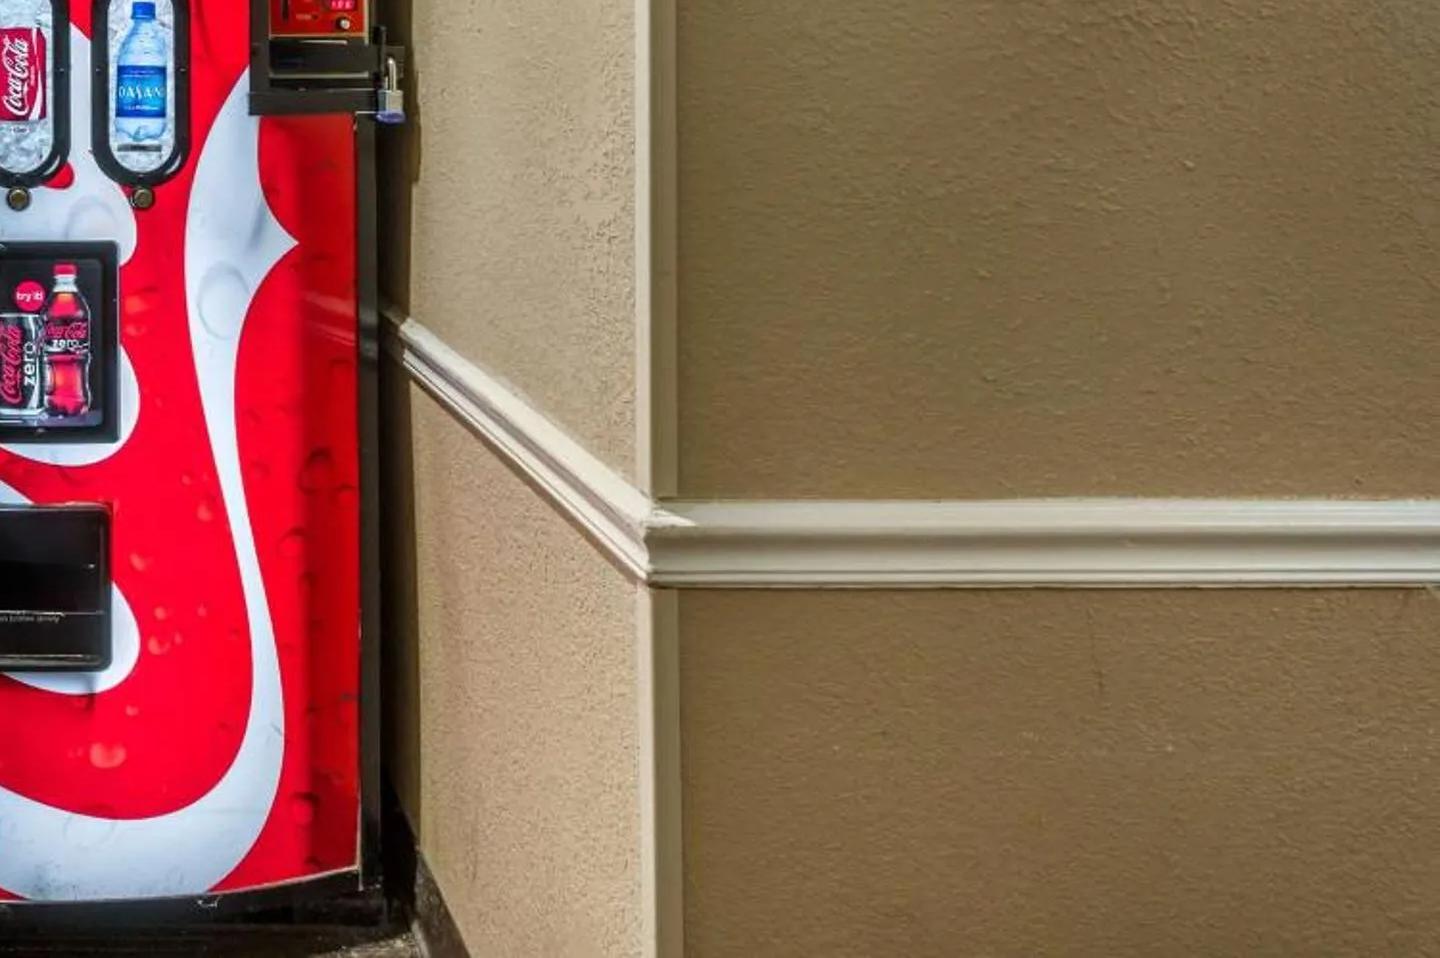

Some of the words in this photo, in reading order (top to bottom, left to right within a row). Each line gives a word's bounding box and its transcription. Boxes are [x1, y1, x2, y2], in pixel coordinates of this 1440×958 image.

[16, 292, 31, 302] try
[52, 339, 79, 349] zero
[23, 341, 36, 386] zero
